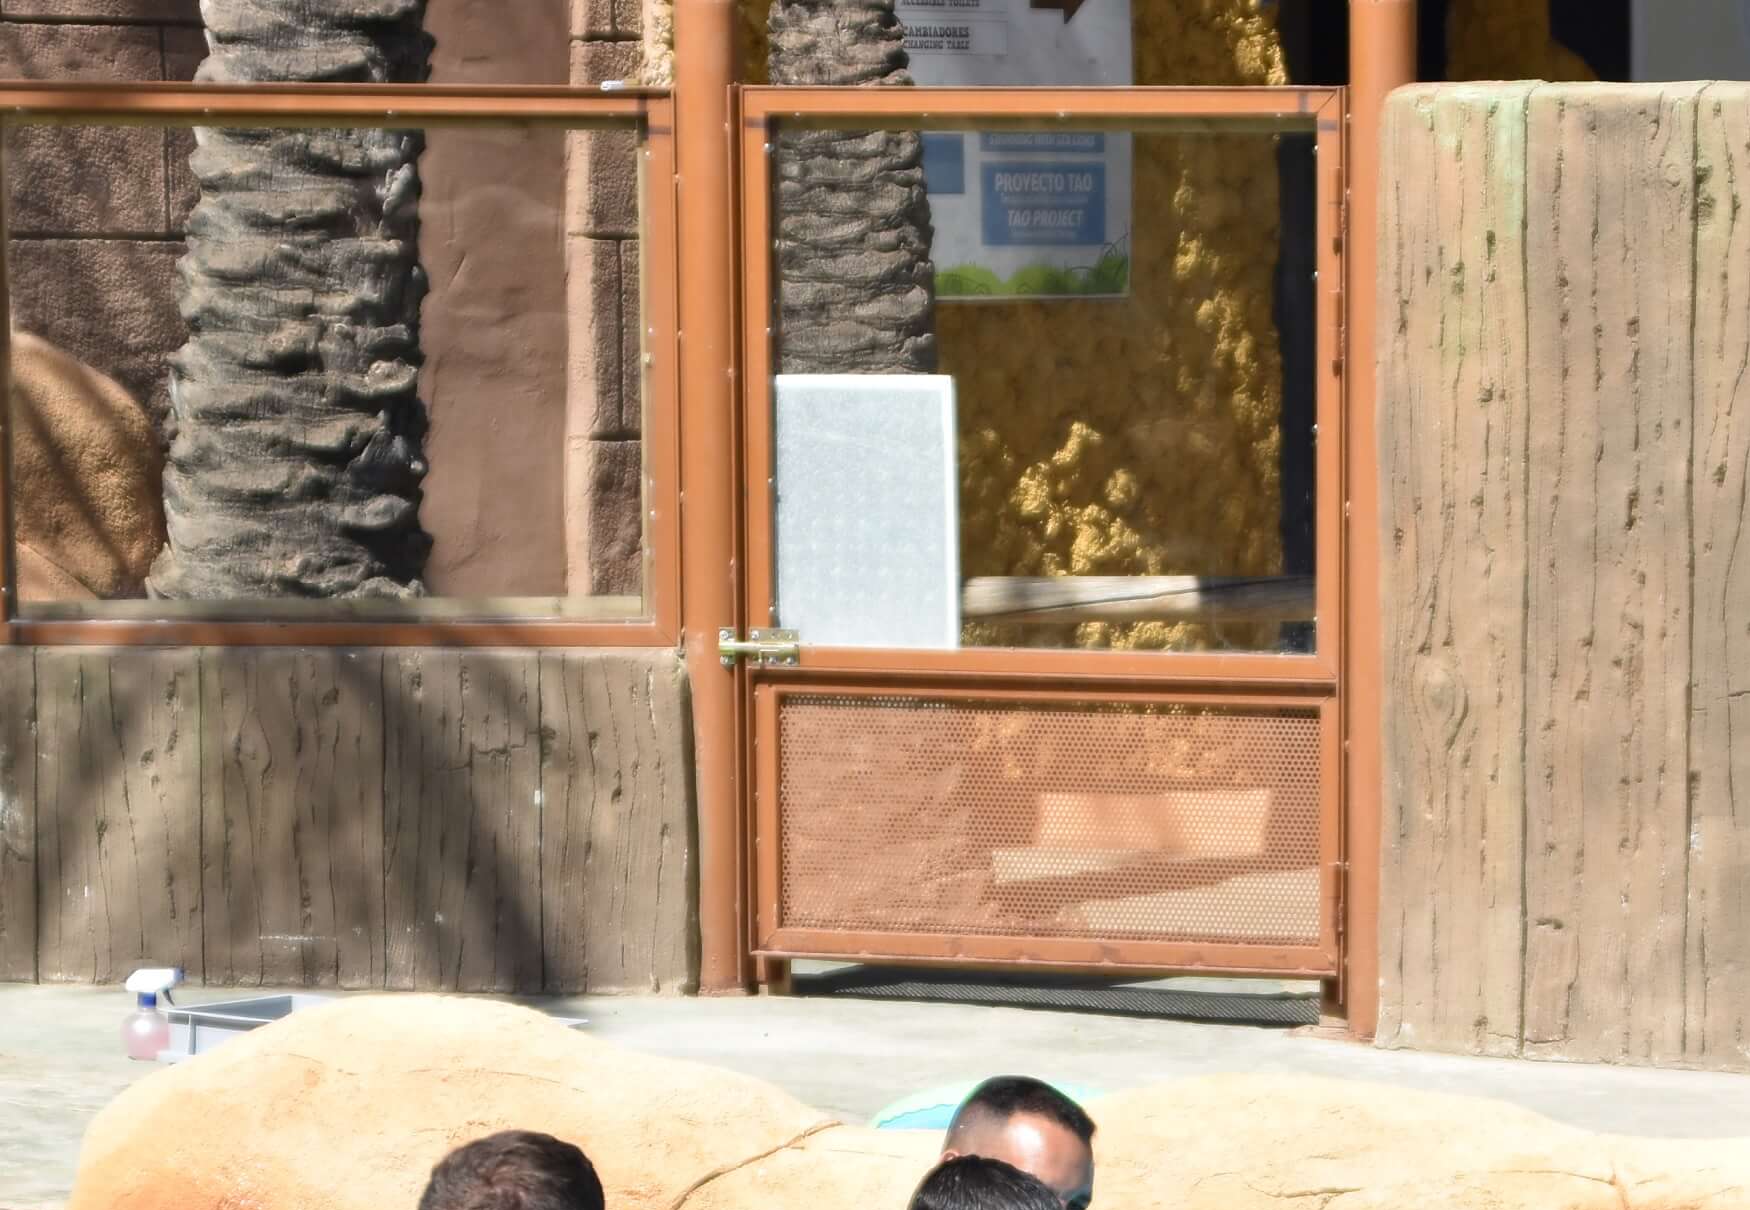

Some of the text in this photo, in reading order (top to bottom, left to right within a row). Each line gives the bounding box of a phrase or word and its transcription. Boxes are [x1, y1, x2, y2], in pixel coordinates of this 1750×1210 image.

[994, 173, 1093, 192] PROYECTO TAO
[1007, 209, 1084, 227] TAO PROJECT
